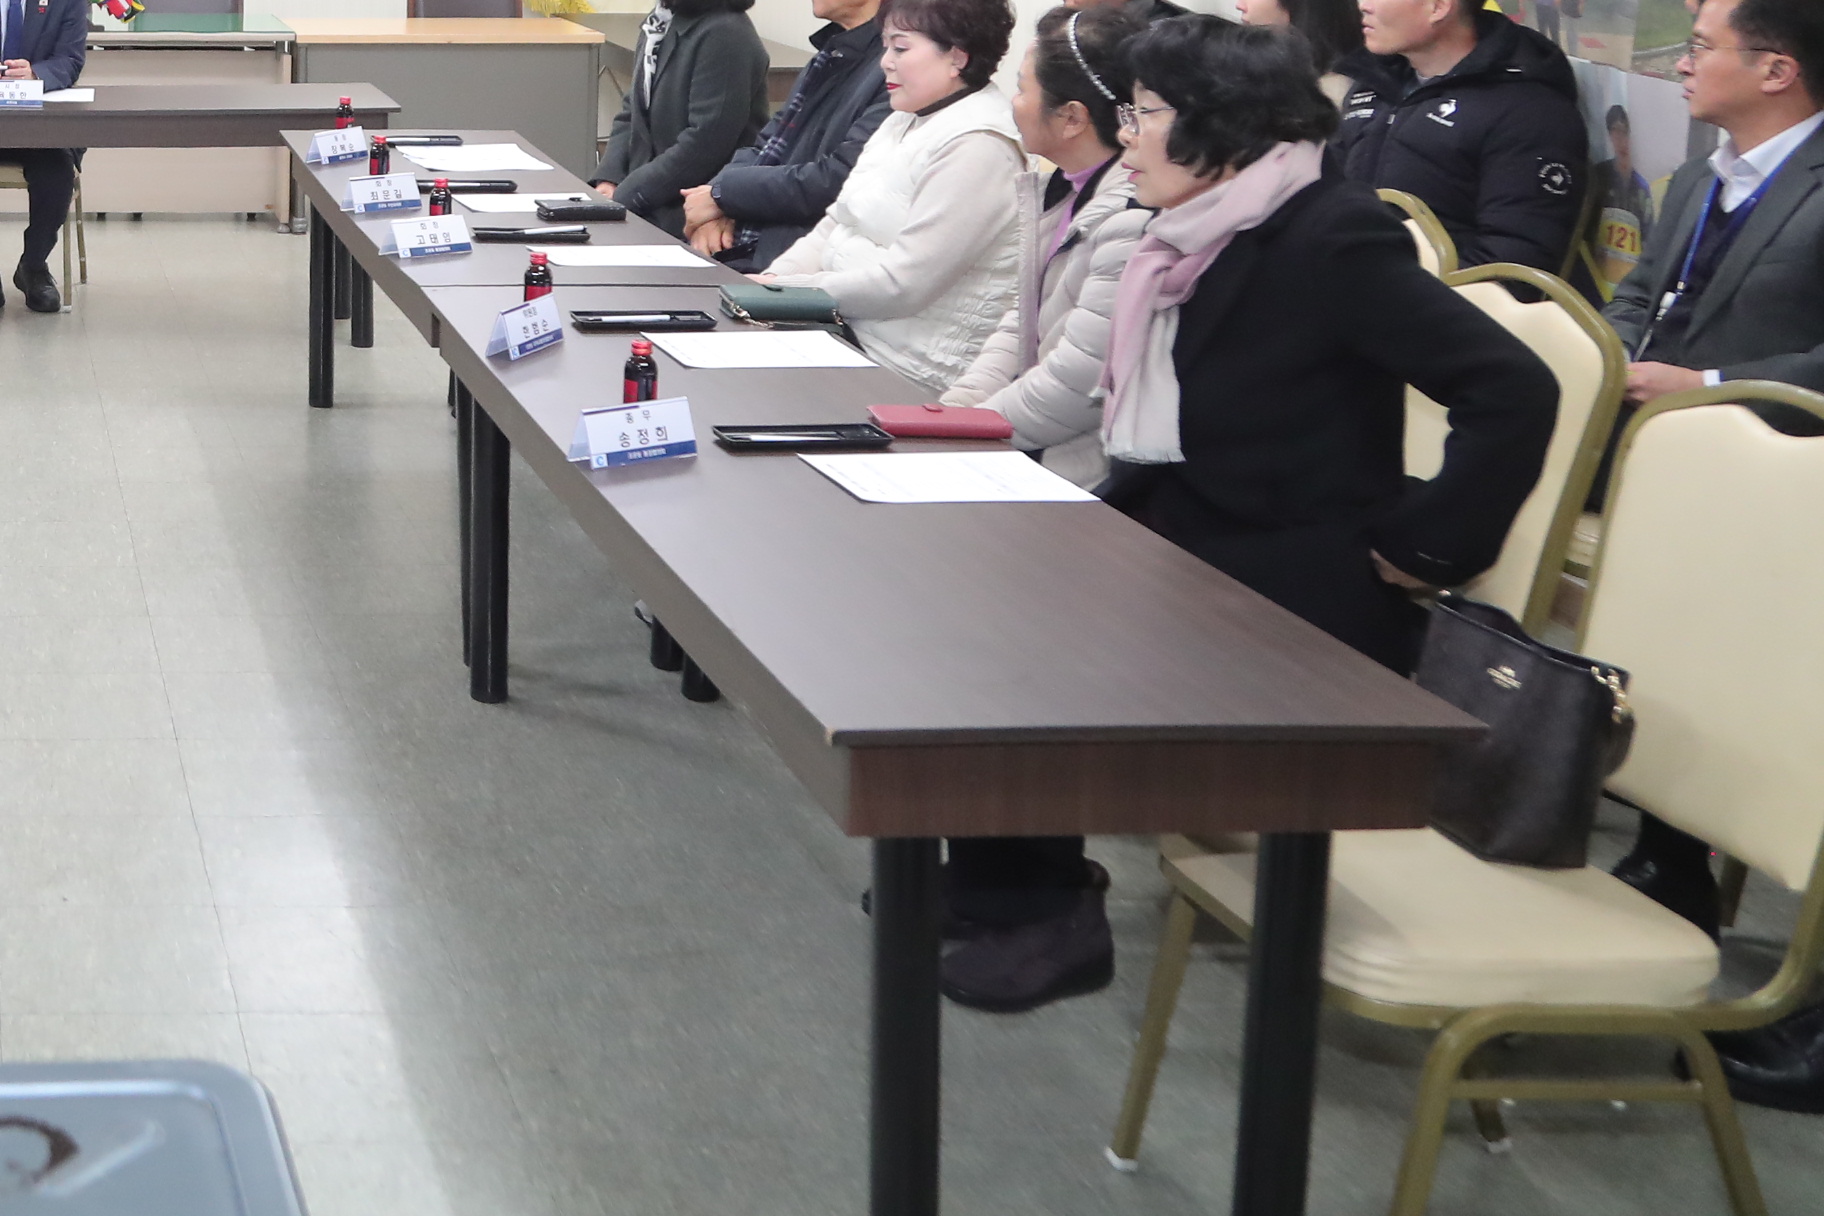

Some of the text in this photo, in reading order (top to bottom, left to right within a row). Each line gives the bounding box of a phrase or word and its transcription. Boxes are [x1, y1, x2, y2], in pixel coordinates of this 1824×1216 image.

[1607, 224, 1636, 252] 121
[625, 410, 651, 424] 총무
[619, 425, 669, 448] 송정희
